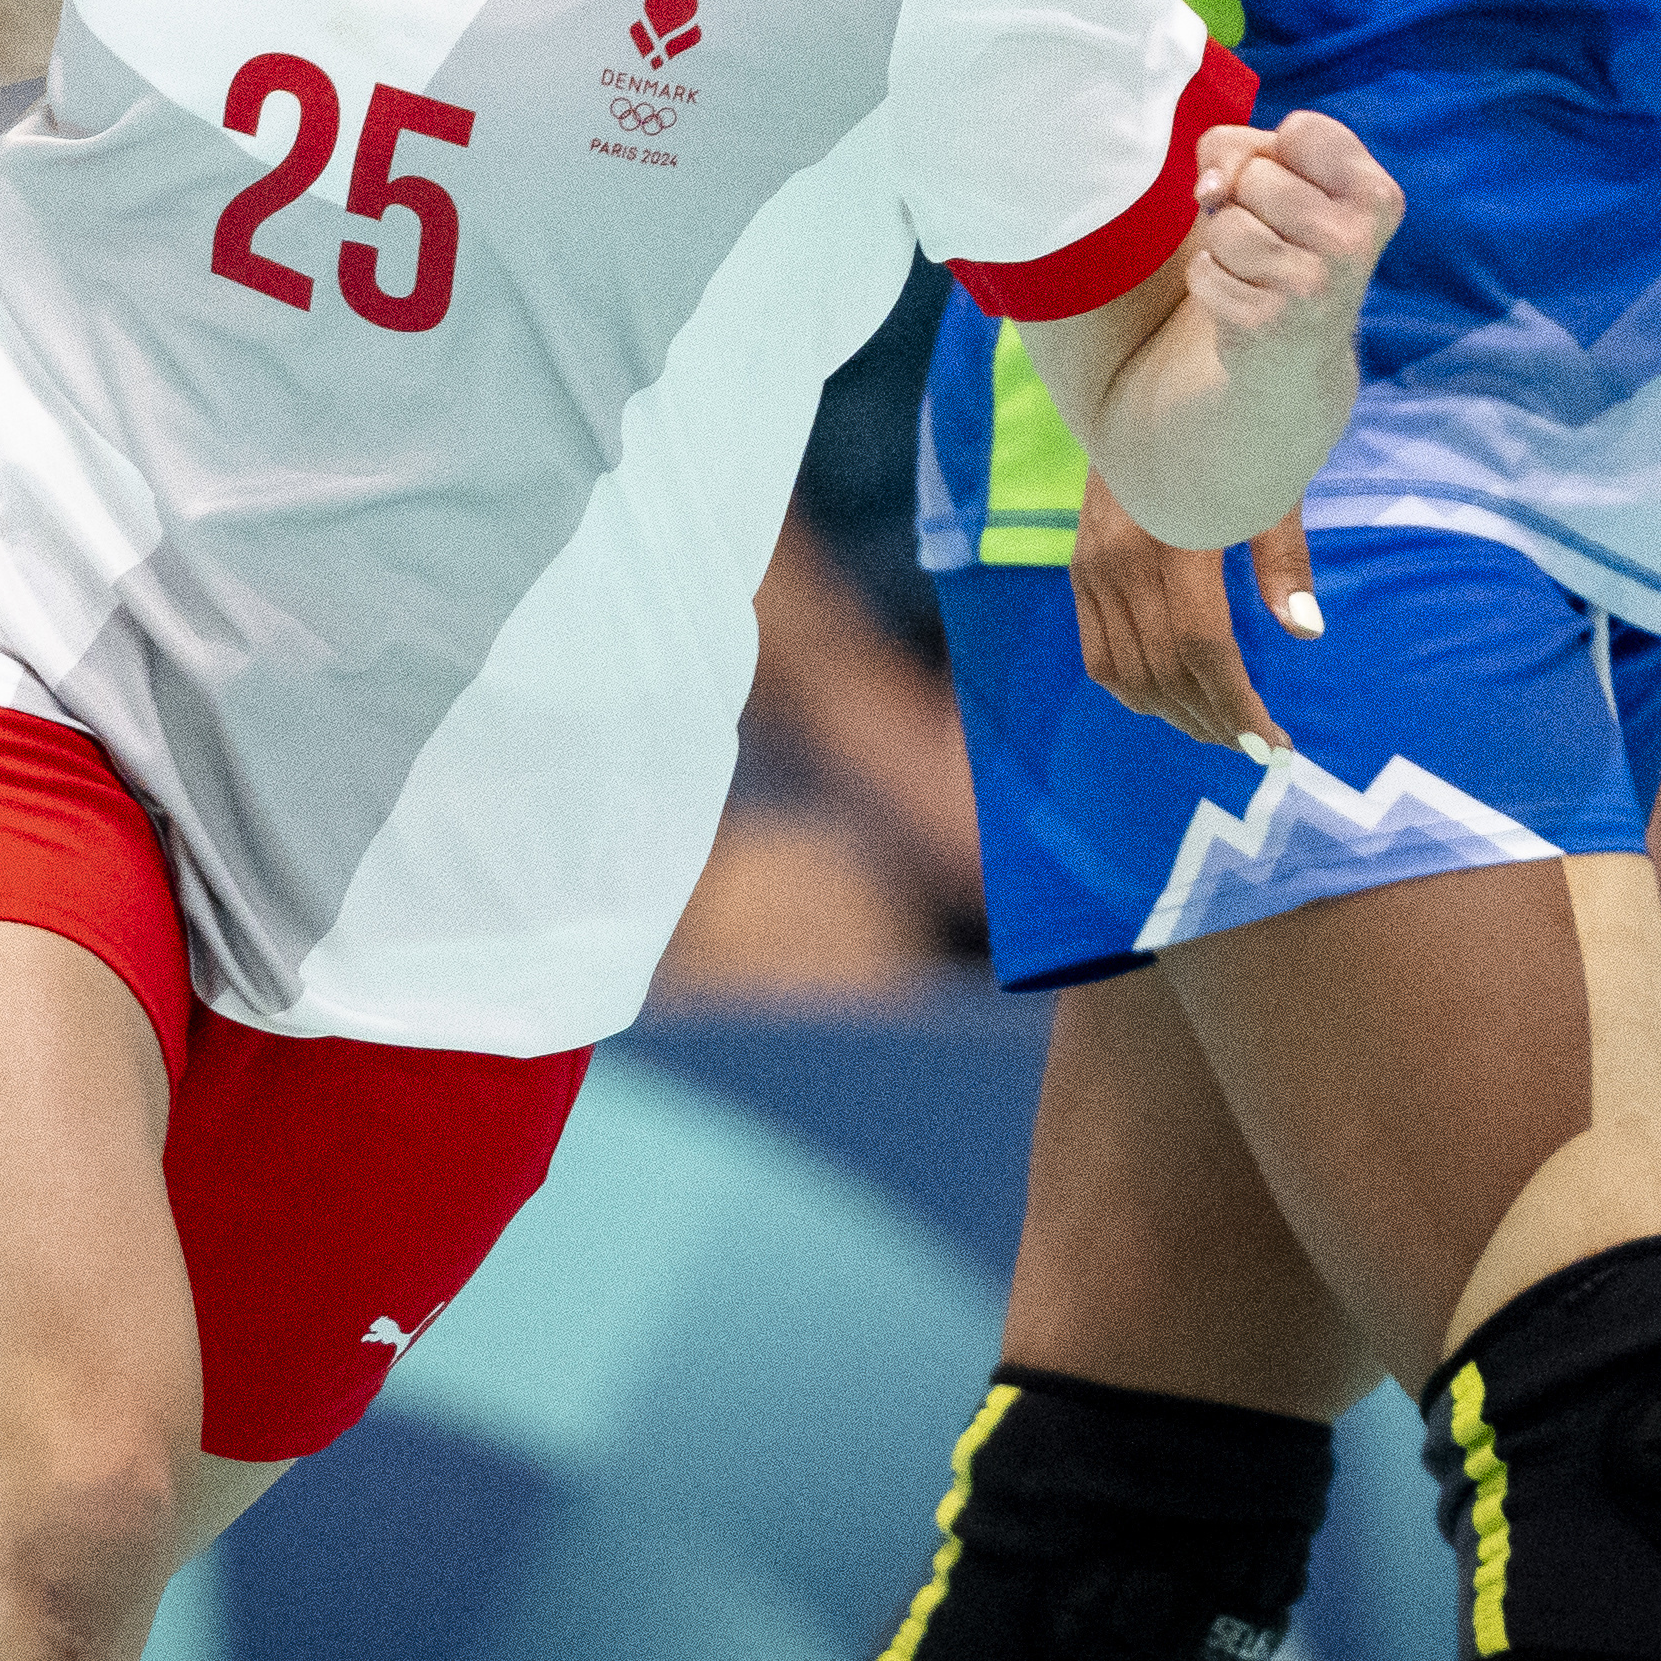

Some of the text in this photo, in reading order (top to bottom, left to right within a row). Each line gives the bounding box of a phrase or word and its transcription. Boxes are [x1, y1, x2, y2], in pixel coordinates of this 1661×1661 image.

[600, 68, 699, 104] DENMARK
[590, 138, 678, 167] PARIS 2024
[210, 52, 476, 332] 25
